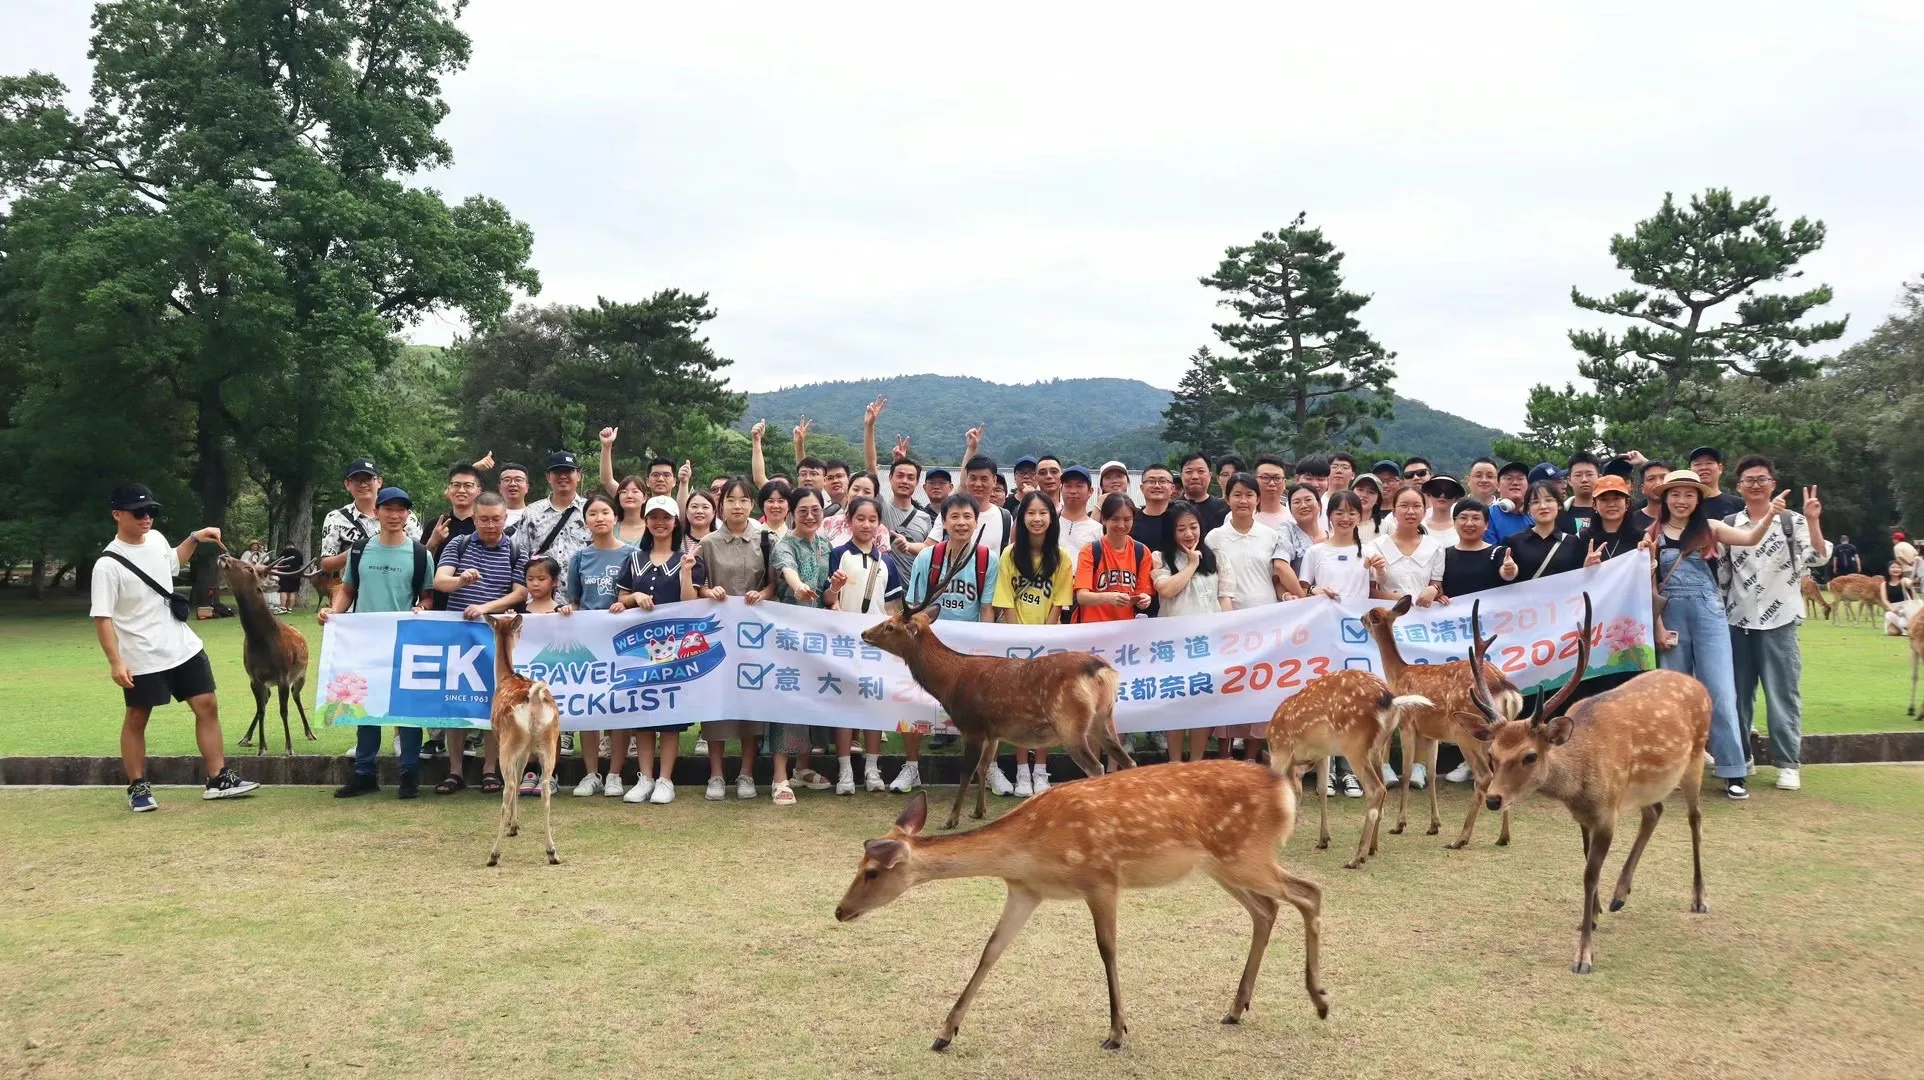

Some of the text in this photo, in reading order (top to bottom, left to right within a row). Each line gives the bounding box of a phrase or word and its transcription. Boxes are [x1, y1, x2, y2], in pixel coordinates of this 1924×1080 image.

[942, 597, 965, 610] 1994
[1020, 590, 1041, 606] 1994
[1493, 595, 1584, 635] 2017
[616, 622, 707, 650] WELCOME TO
[1219, 624, 1311, 655] 2016
[1501, 622, 1604, 672] 2024
[399, 644, 488, 692] EK
[638, 662, 700, 683] JAPAN
[1221, 656, 1330, 694] 2023
[444, 694, 489, 703] SINCE 1963
[775, 667, 884, 701] 意大利
